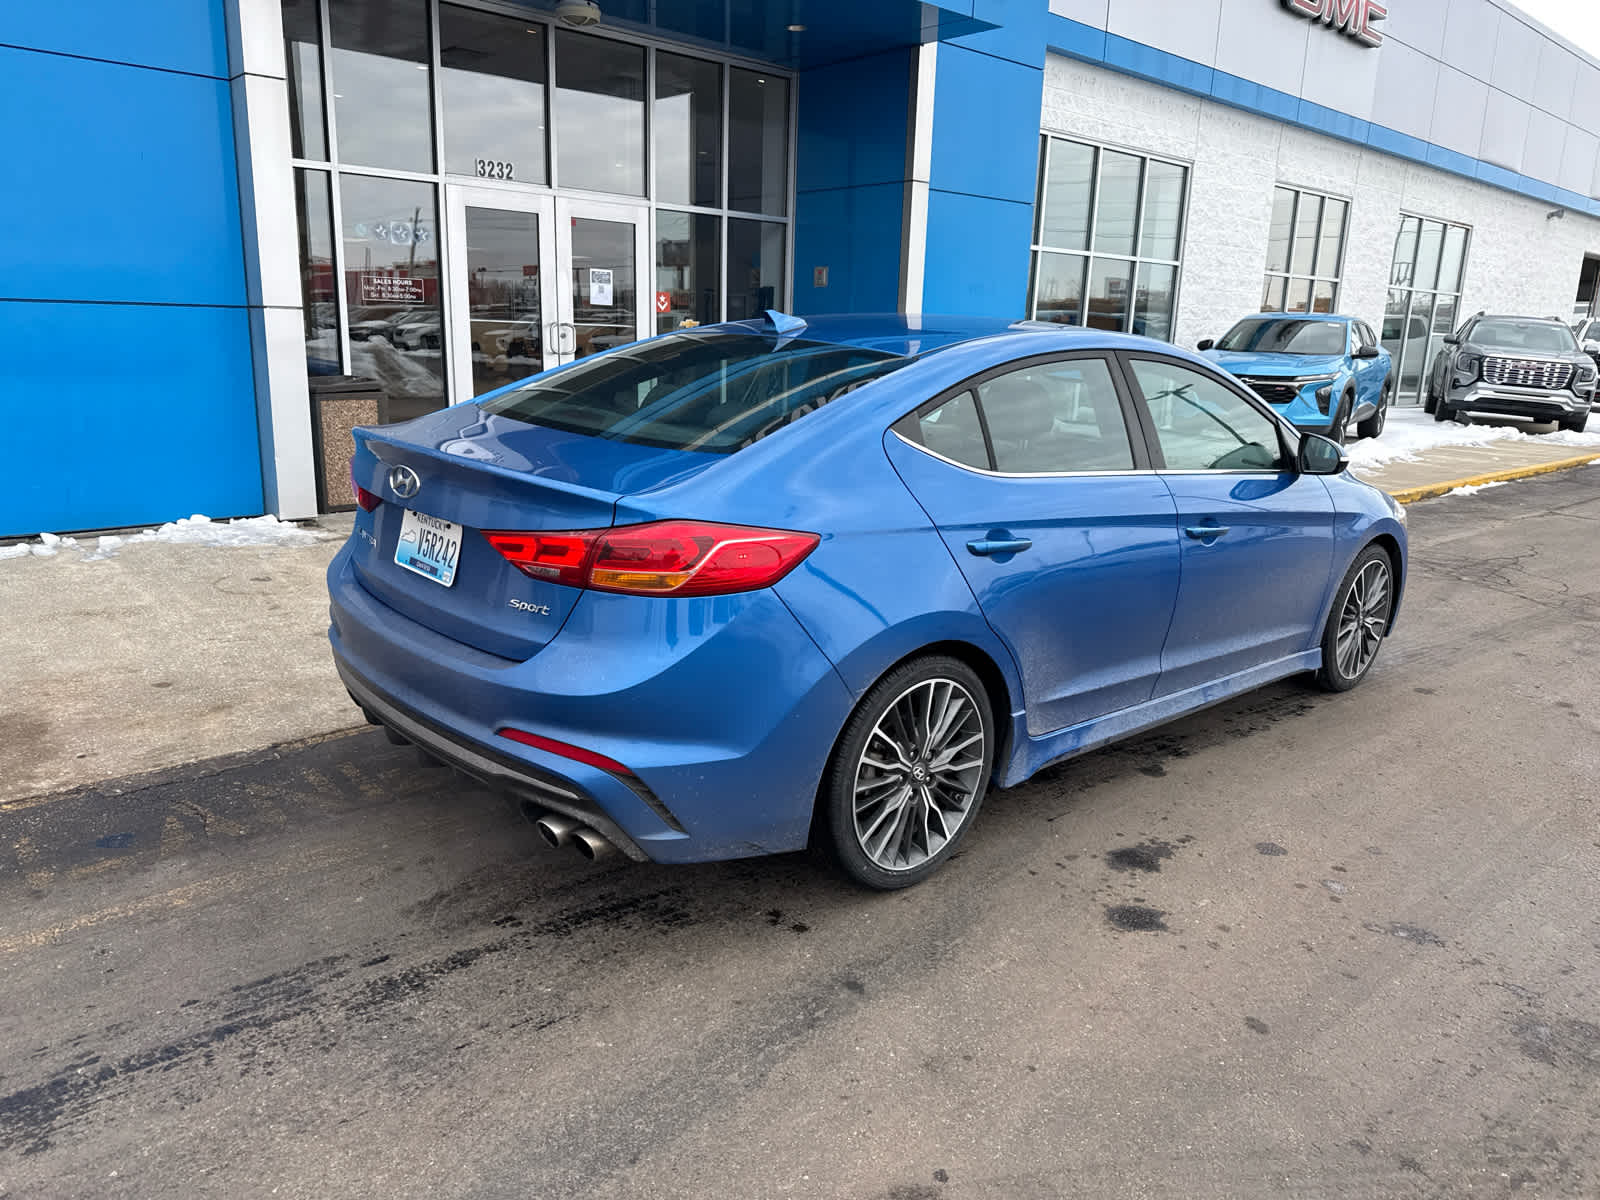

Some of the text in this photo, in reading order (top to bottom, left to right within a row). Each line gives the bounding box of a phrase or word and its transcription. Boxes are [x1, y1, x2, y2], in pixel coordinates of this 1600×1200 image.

[478, 159, 513, 180] 3232
[416, 512, 447, 531] KENTUCKY
[417, 528, 457, 569] V5R242
[508, 598, 551, 616] Sport
